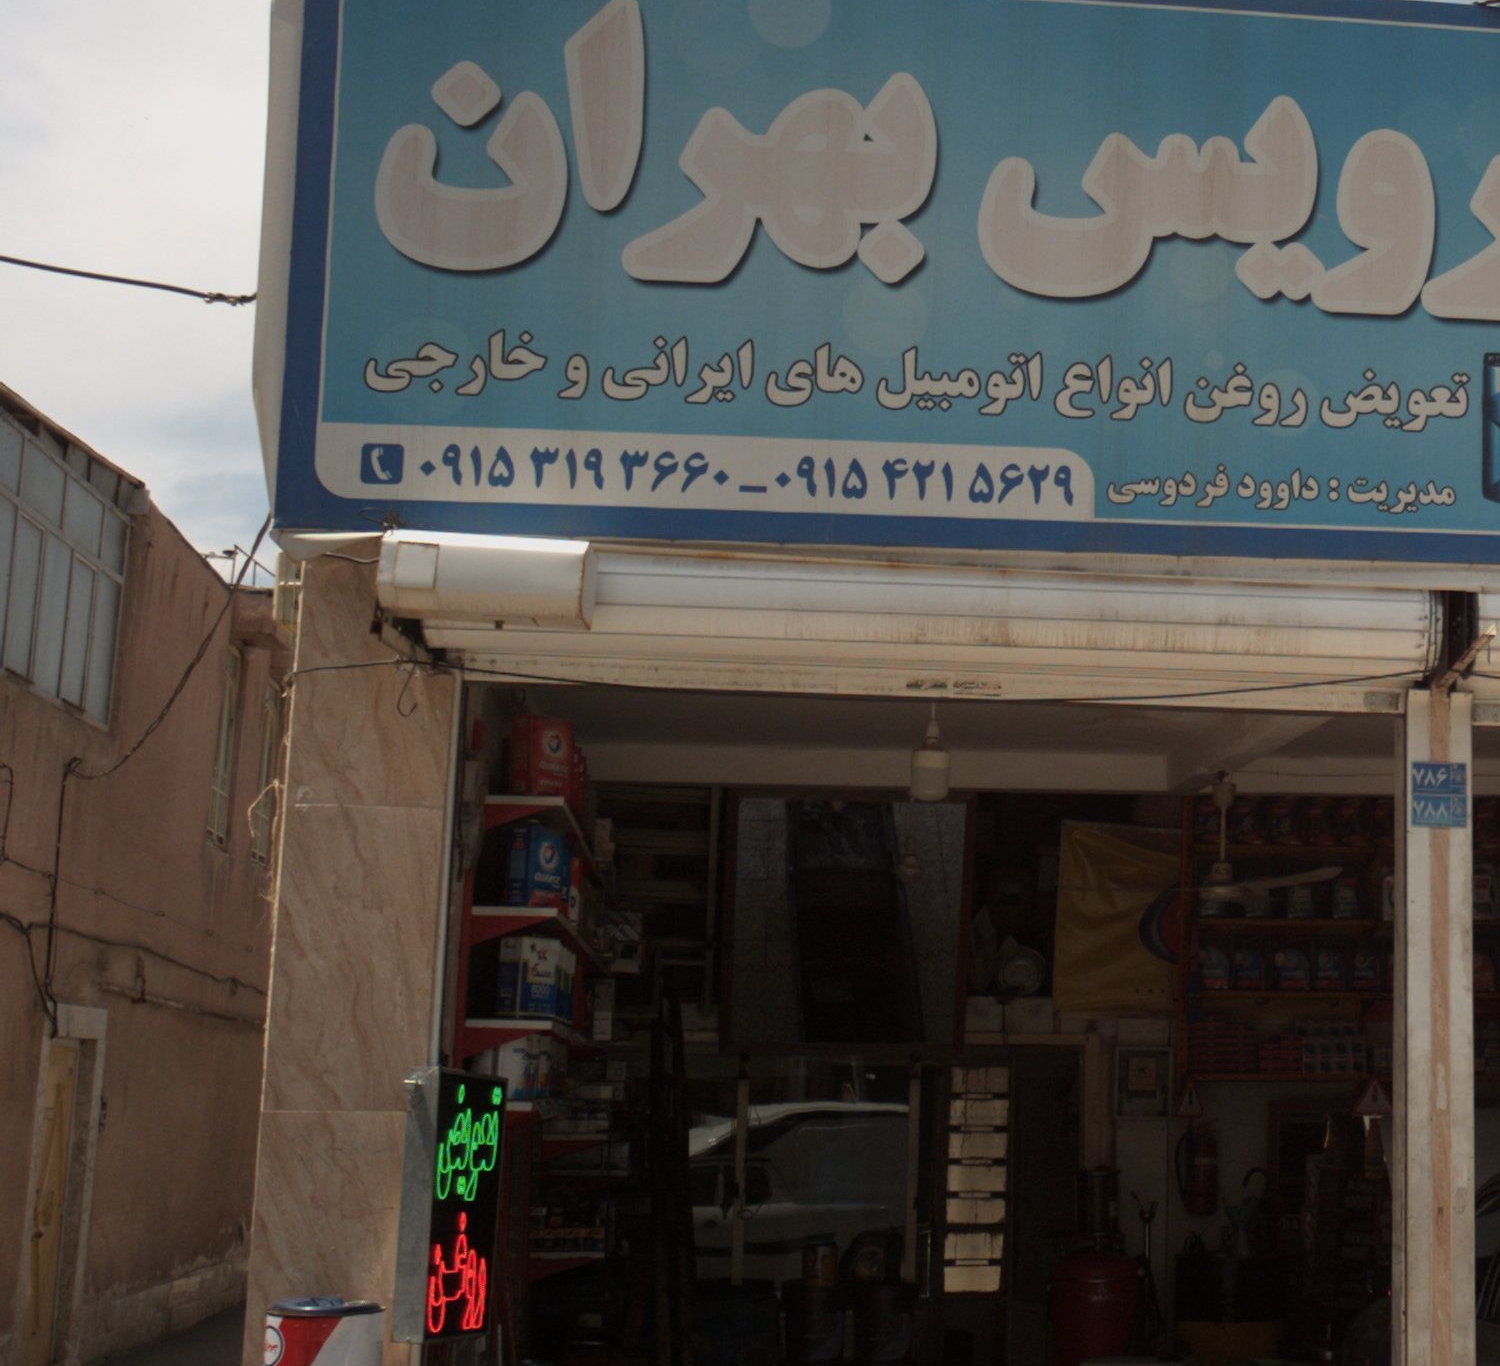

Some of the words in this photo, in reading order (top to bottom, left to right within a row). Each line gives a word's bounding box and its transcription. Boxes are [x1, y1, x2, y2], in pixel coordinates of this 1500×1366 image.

[364, 328, 548, 397] خارجی
[557, 353, 590, 400] و
[602, 336, 754, 404] ایرانی
[765, 341, 864, 407] های
[876, 345, 1043, 415] اتومبیل
[1053, 354, 1174, 420] انواع
[1184, 363, 1308, 427] روغن
[1319, 368, 1471, 432] تعویض
[1106, 464, 1230, 507] فردوسی
[1236, 468, 1320, 510] داوود
[1347, 476, 1456, 514] مدیریت
[436, 1084, 503, 1201] تعویض
[427, 1211, 488, 1333] روغن
